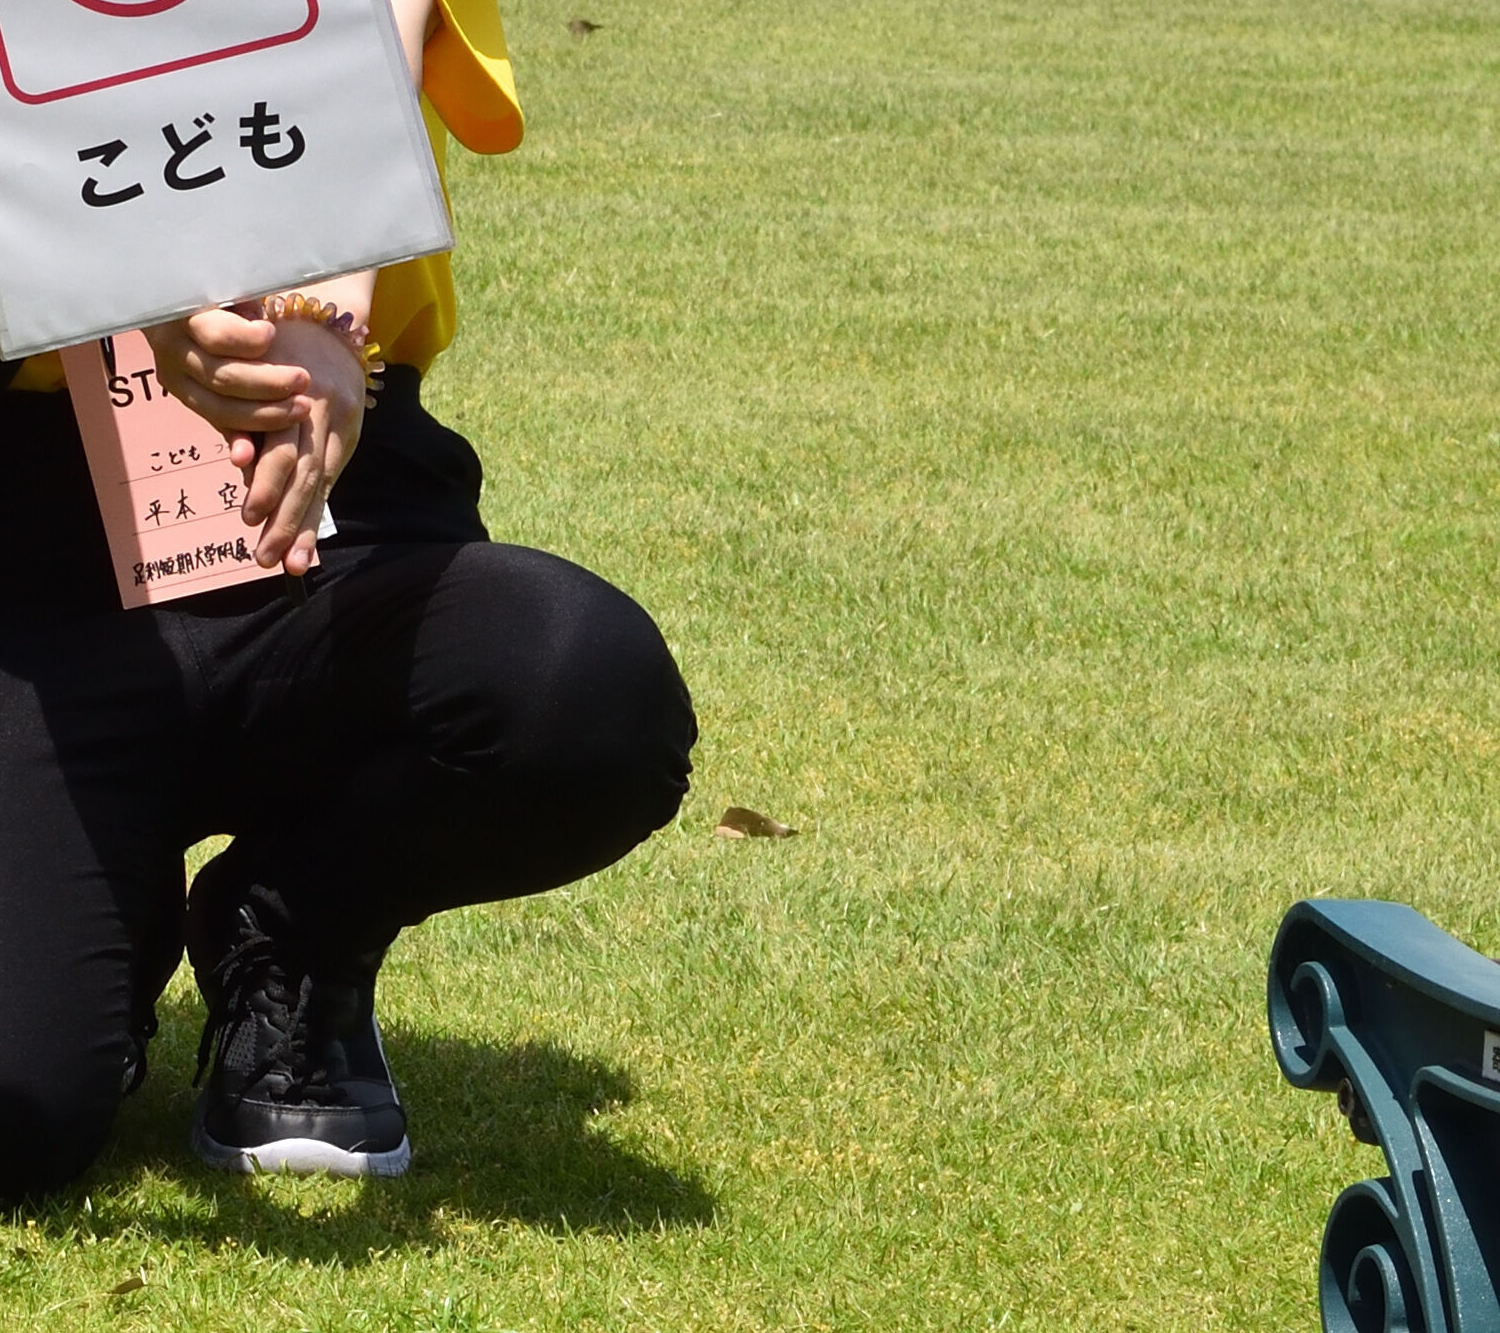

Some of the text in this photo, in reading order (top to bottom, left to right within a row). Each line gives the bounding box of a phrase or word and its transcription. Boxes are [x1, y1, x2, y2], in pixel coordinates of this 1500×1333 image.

[77, 101, 306, 208] こども
[150, 446, 200, 471] こども
[145, 489, 196, 526] 平本
